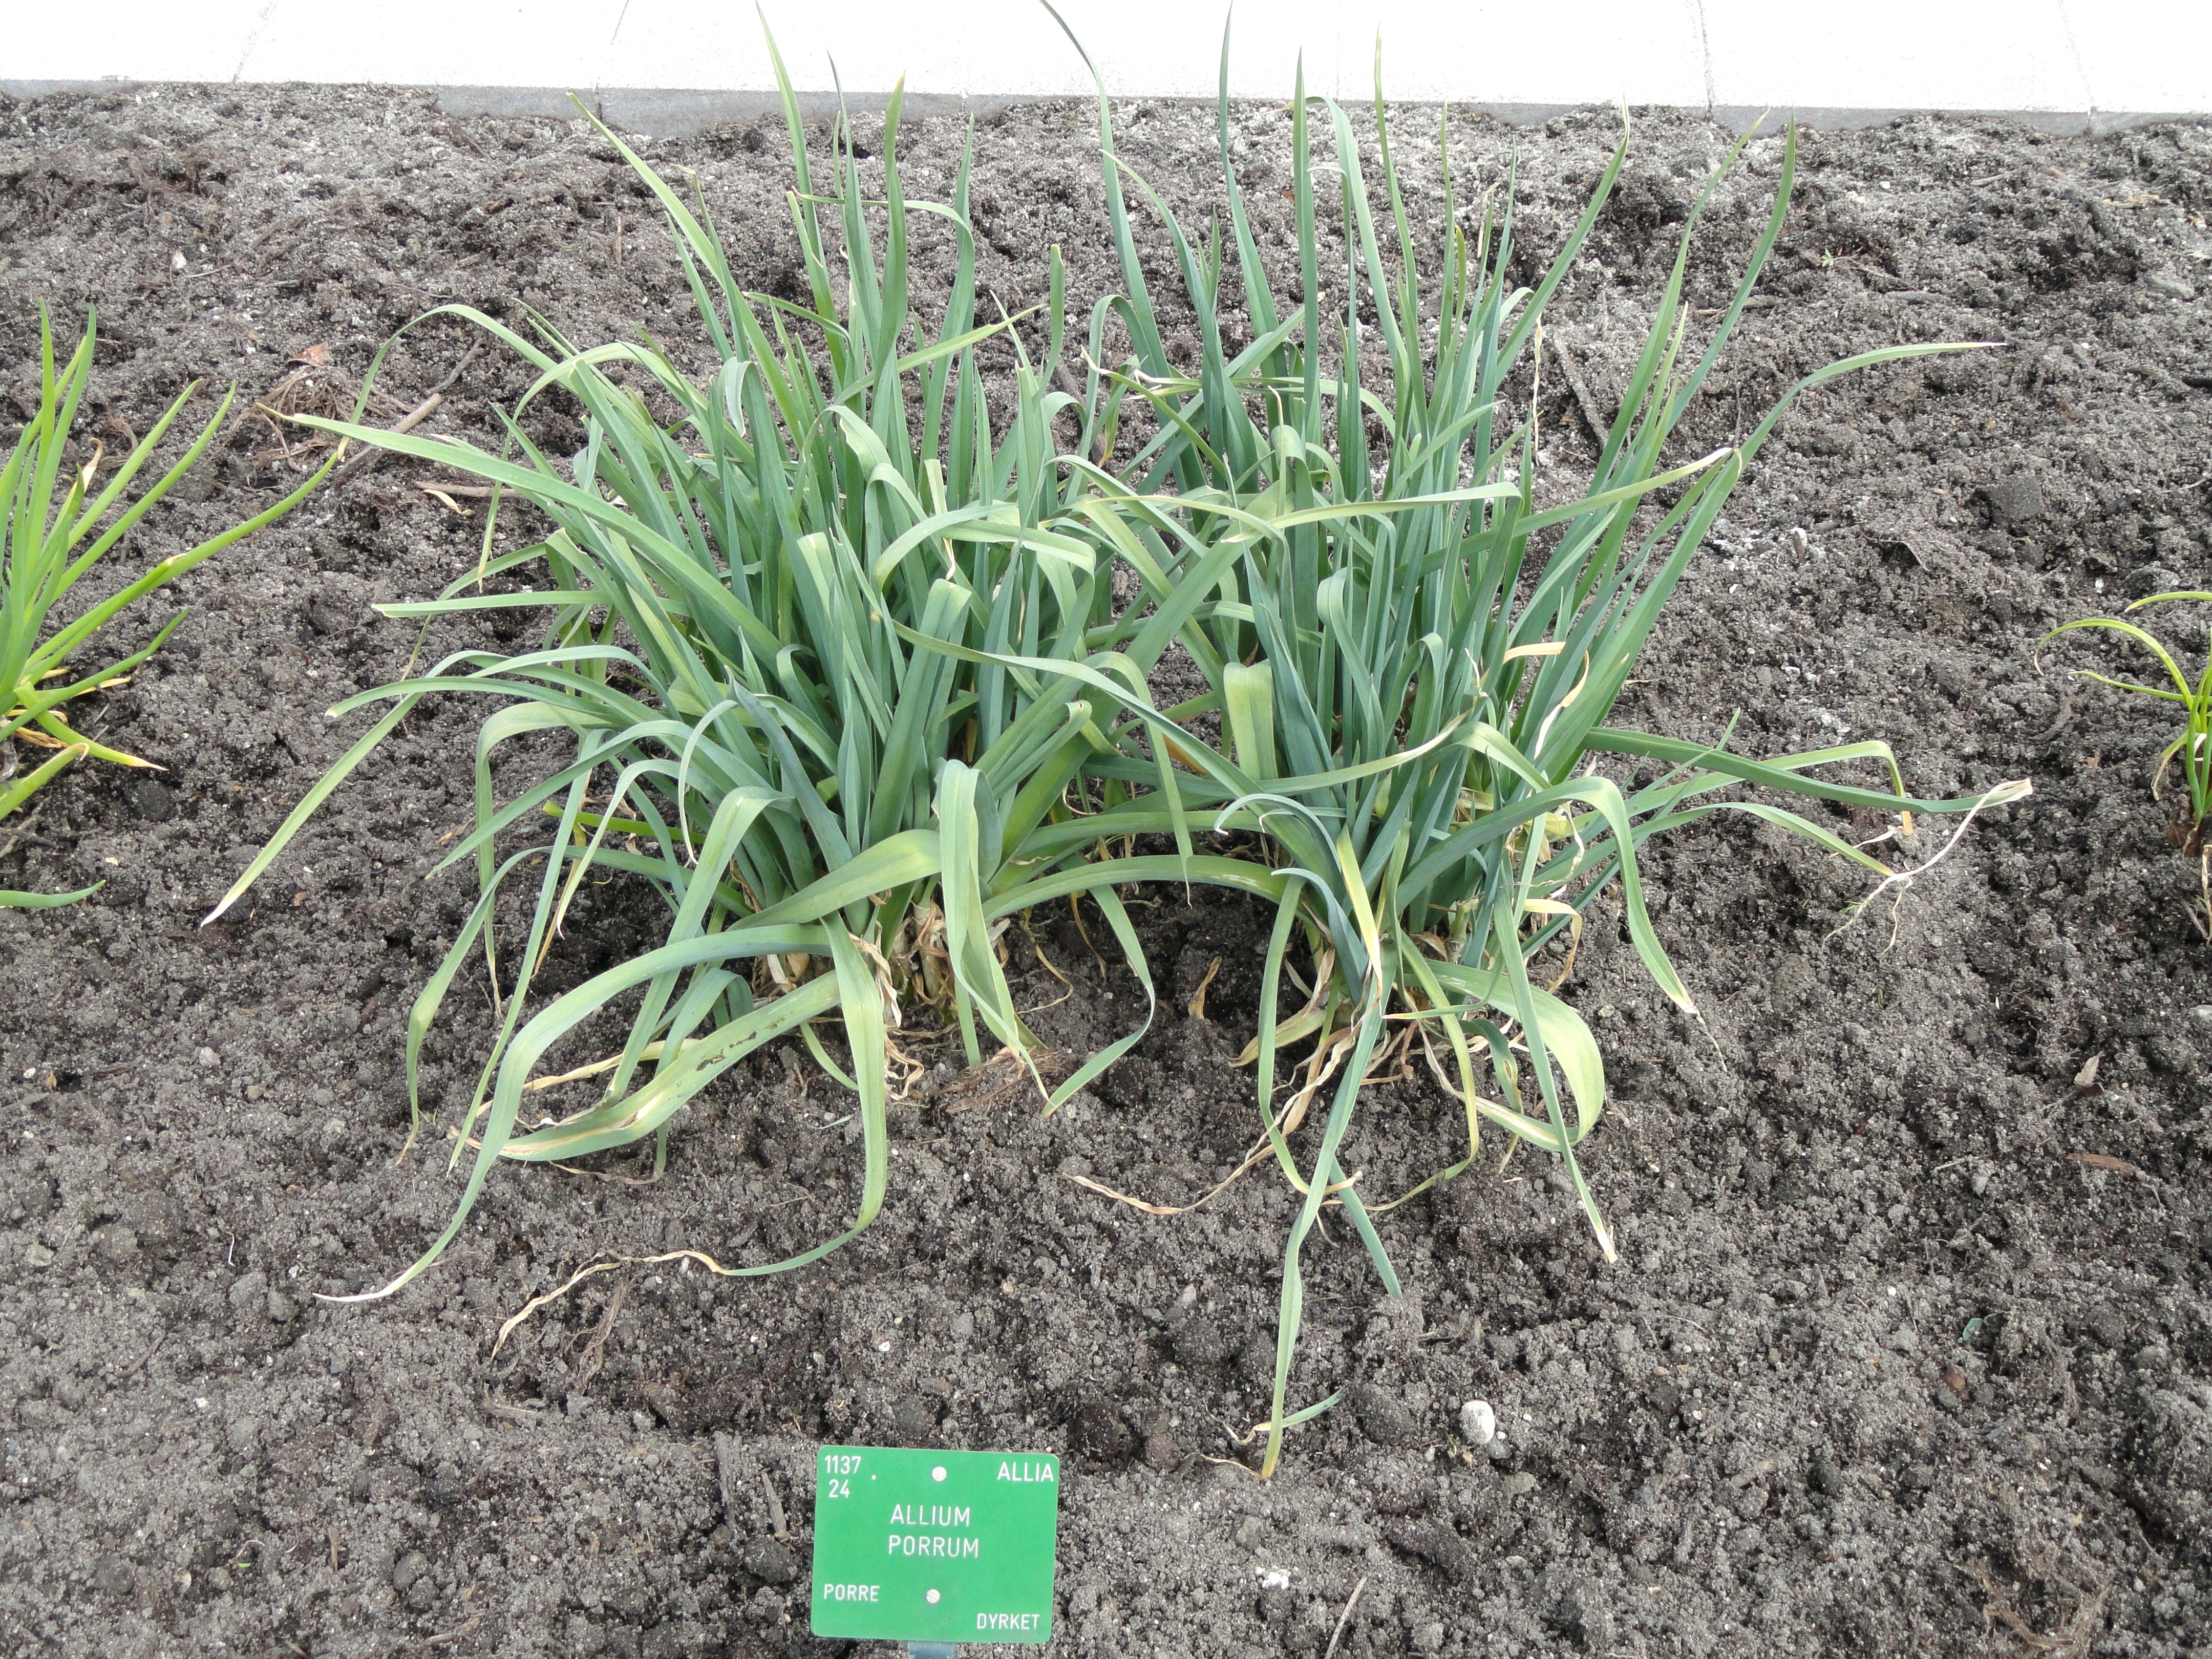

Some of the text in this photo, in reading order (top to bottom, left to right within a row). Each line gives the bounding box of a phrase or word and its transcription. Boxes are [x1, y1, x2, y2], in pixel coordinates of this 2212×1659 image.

[824, 1455, 862, 1475] 1137
[997, 1461, 1054, 1482] ALLIA
[828, 1478, 850, 1498] 24
[890, 1504, 970, 1527] ALLIUM
[888, 1535, 979, 1558] PORRUM
[823, 1583, 880, 1603] PORRE
[976, 1613, 1040, 1631] DYRKET
